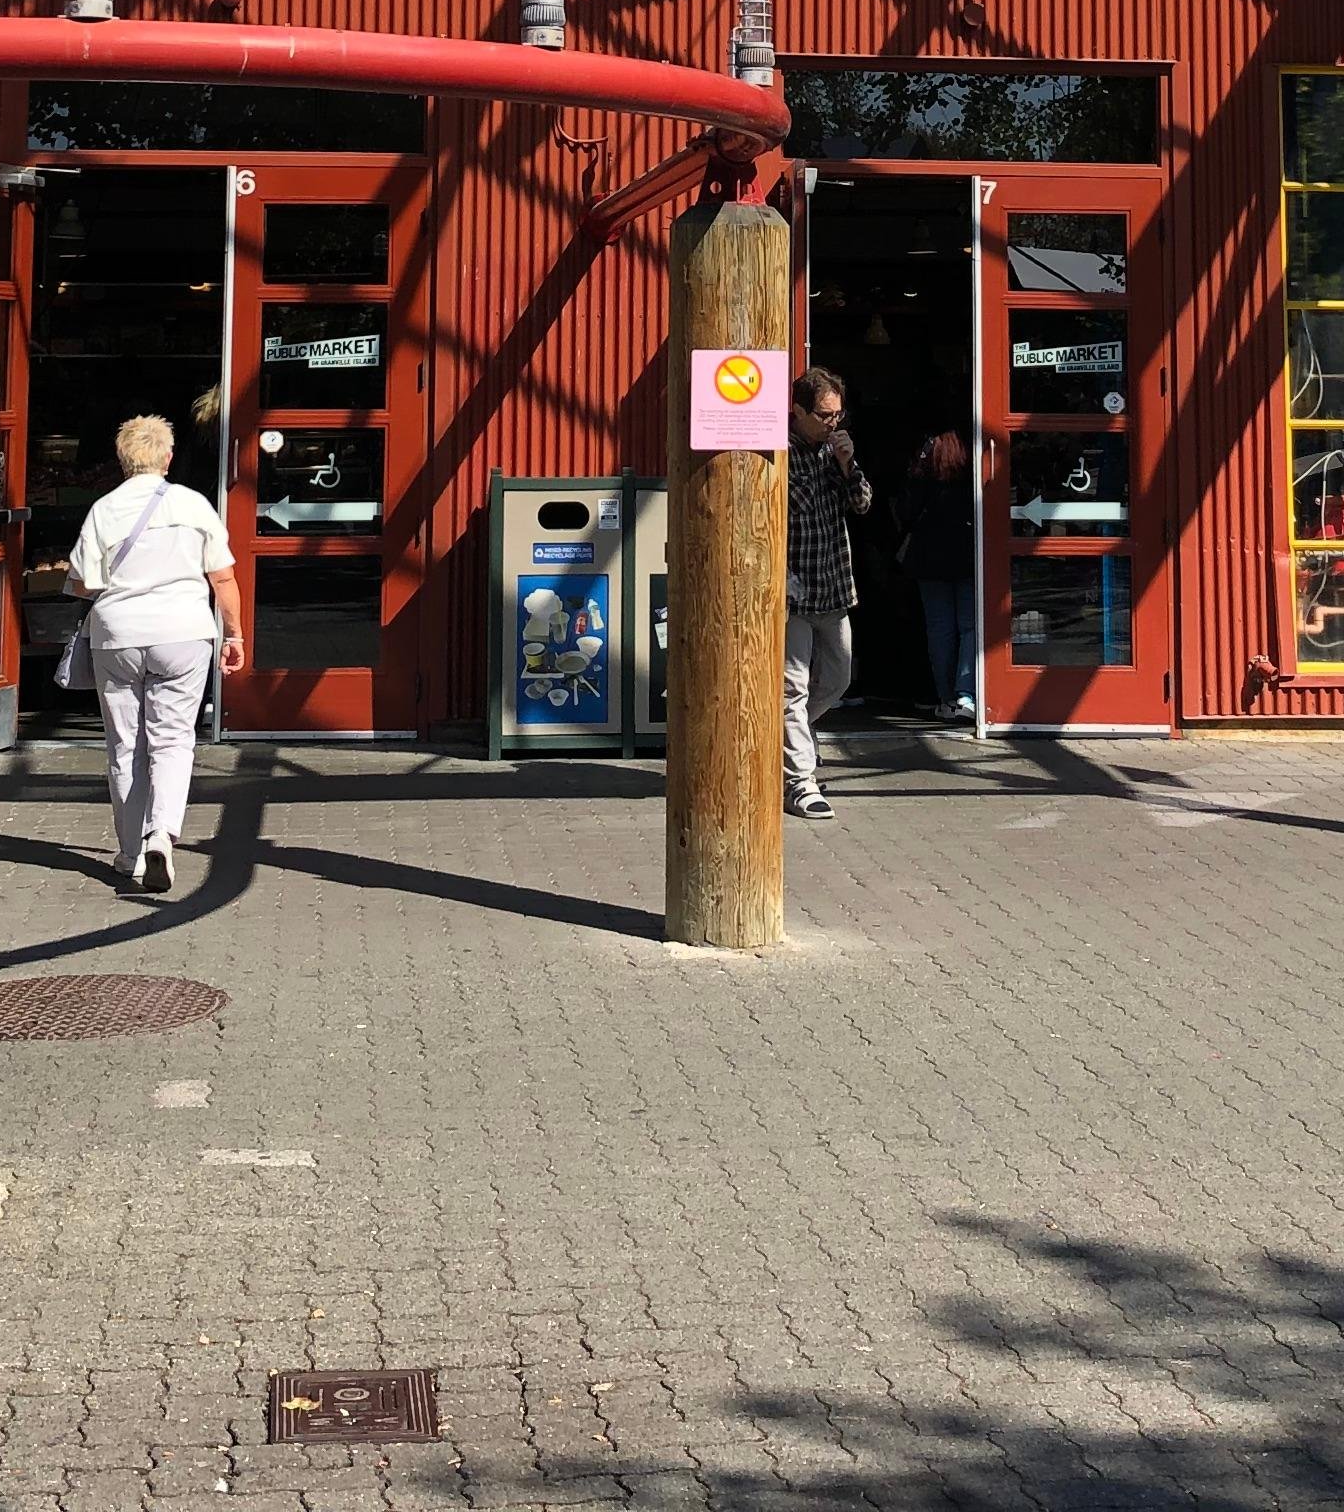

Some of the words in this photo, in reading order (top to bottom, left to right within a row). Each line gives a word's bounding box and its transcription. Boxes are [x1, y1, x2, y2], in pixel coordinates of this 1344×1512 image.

[236, 169, 256, 195] 6
[980, 180, 998, 205] 7
[266, 346, 308, 360] PUBLIC
[309, 338, 377, 357] MARKET
[1015, 351, 1054, 365] PUBLIC
[1056, 344, 1119, 362] MARKET
